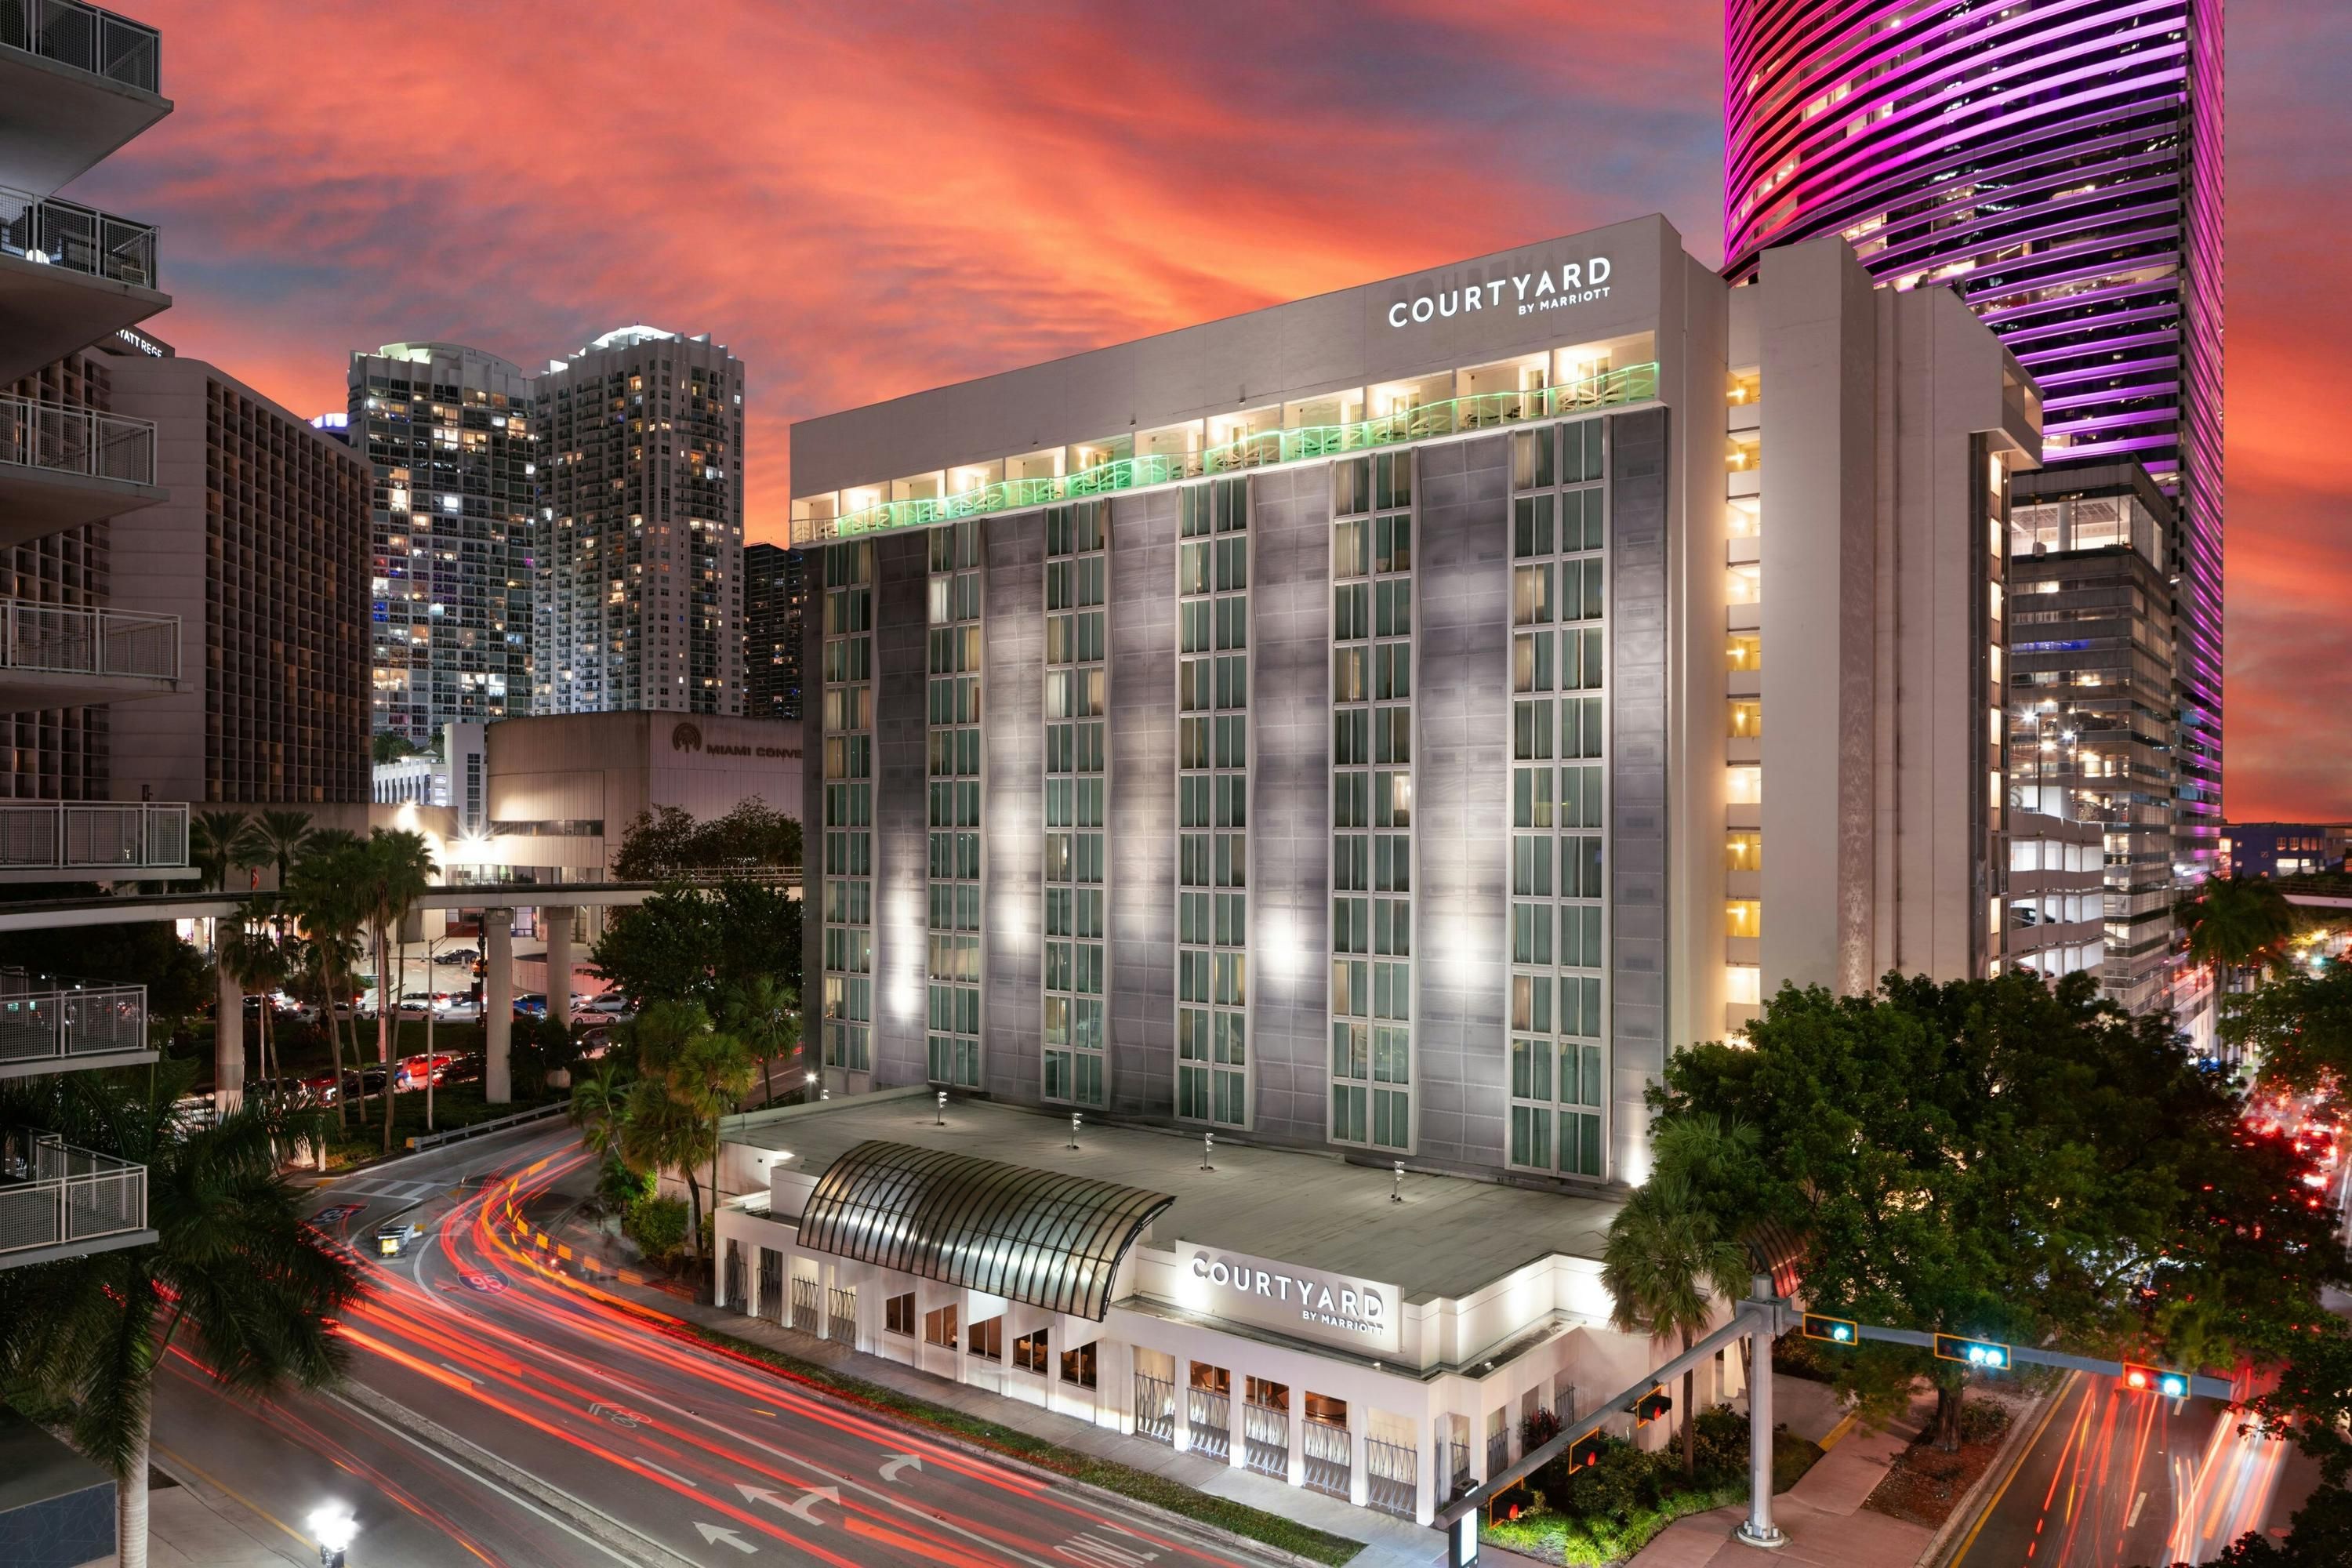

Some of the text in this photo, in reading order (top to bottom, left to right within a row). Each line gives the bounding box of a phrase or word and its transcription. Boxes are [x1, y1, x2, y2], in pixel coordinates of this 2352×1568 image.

[1388, 257, 1610, 327] COURTYARD
[1519, 287, 1610, 315] BY MARRIOTT
[116, 329, 140, 347] YATT
[706, 745, 803, 759] MIAMI CONVE
[470, 1275, 503, 1294] 95
[1192, 1258, 1384, 1320] COURTYARD
[1302, 1310, 1384, 1335] BY MARRIOTT
